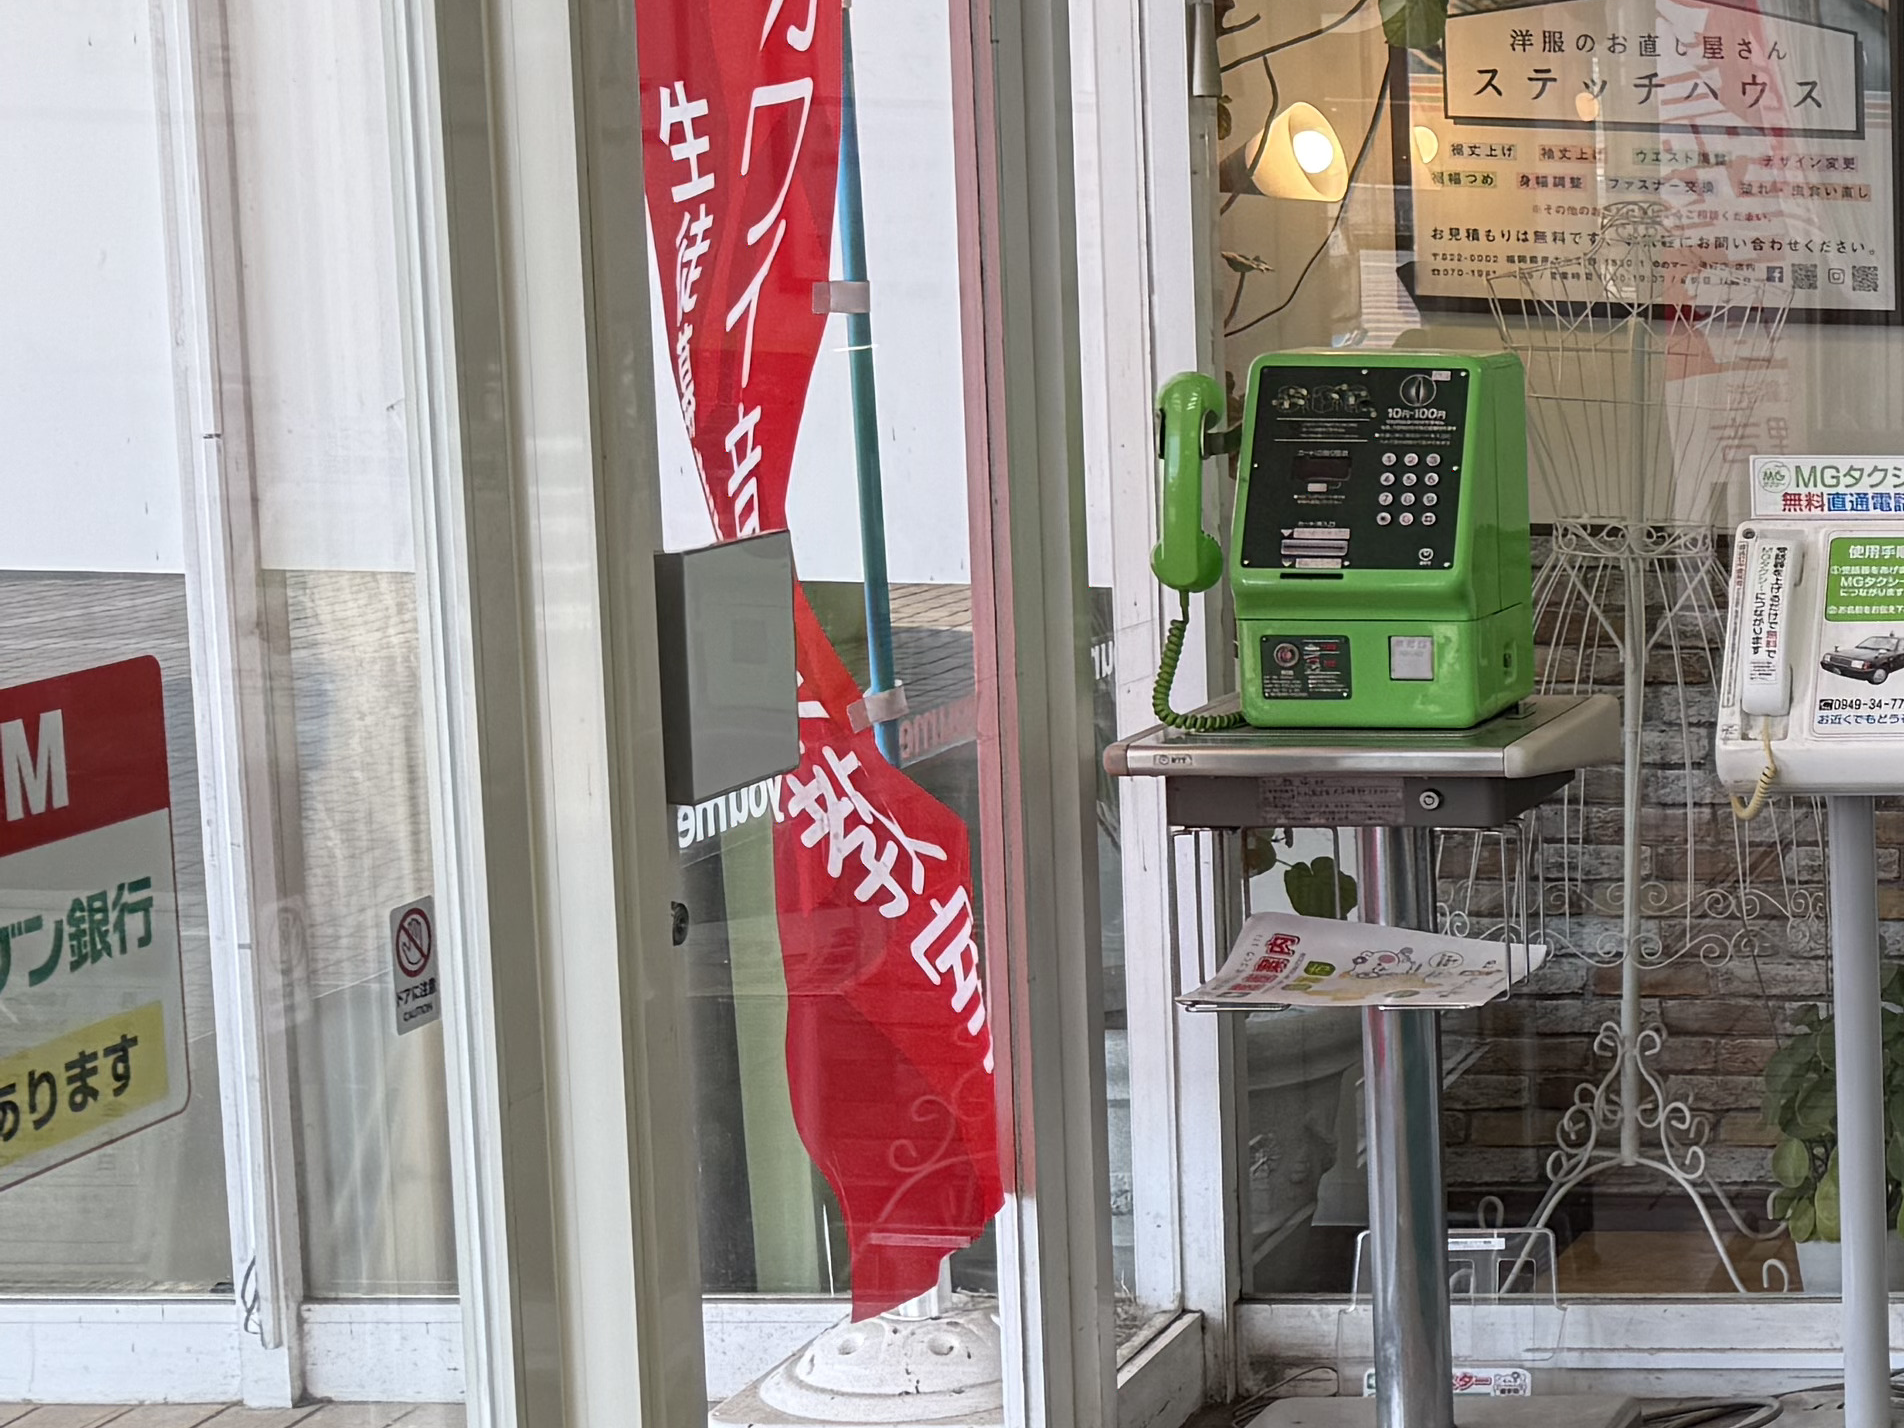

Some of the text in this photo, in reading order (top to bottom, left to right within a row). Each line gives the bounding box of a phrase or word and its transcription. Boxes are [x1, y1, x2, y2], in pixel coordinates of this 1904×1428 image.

[1509, 28, 1789, 62] 洋服のお直し屋さん
[1472, 67, 1825, 112] ステッチハウス
[2, 709, 70, 822] M
